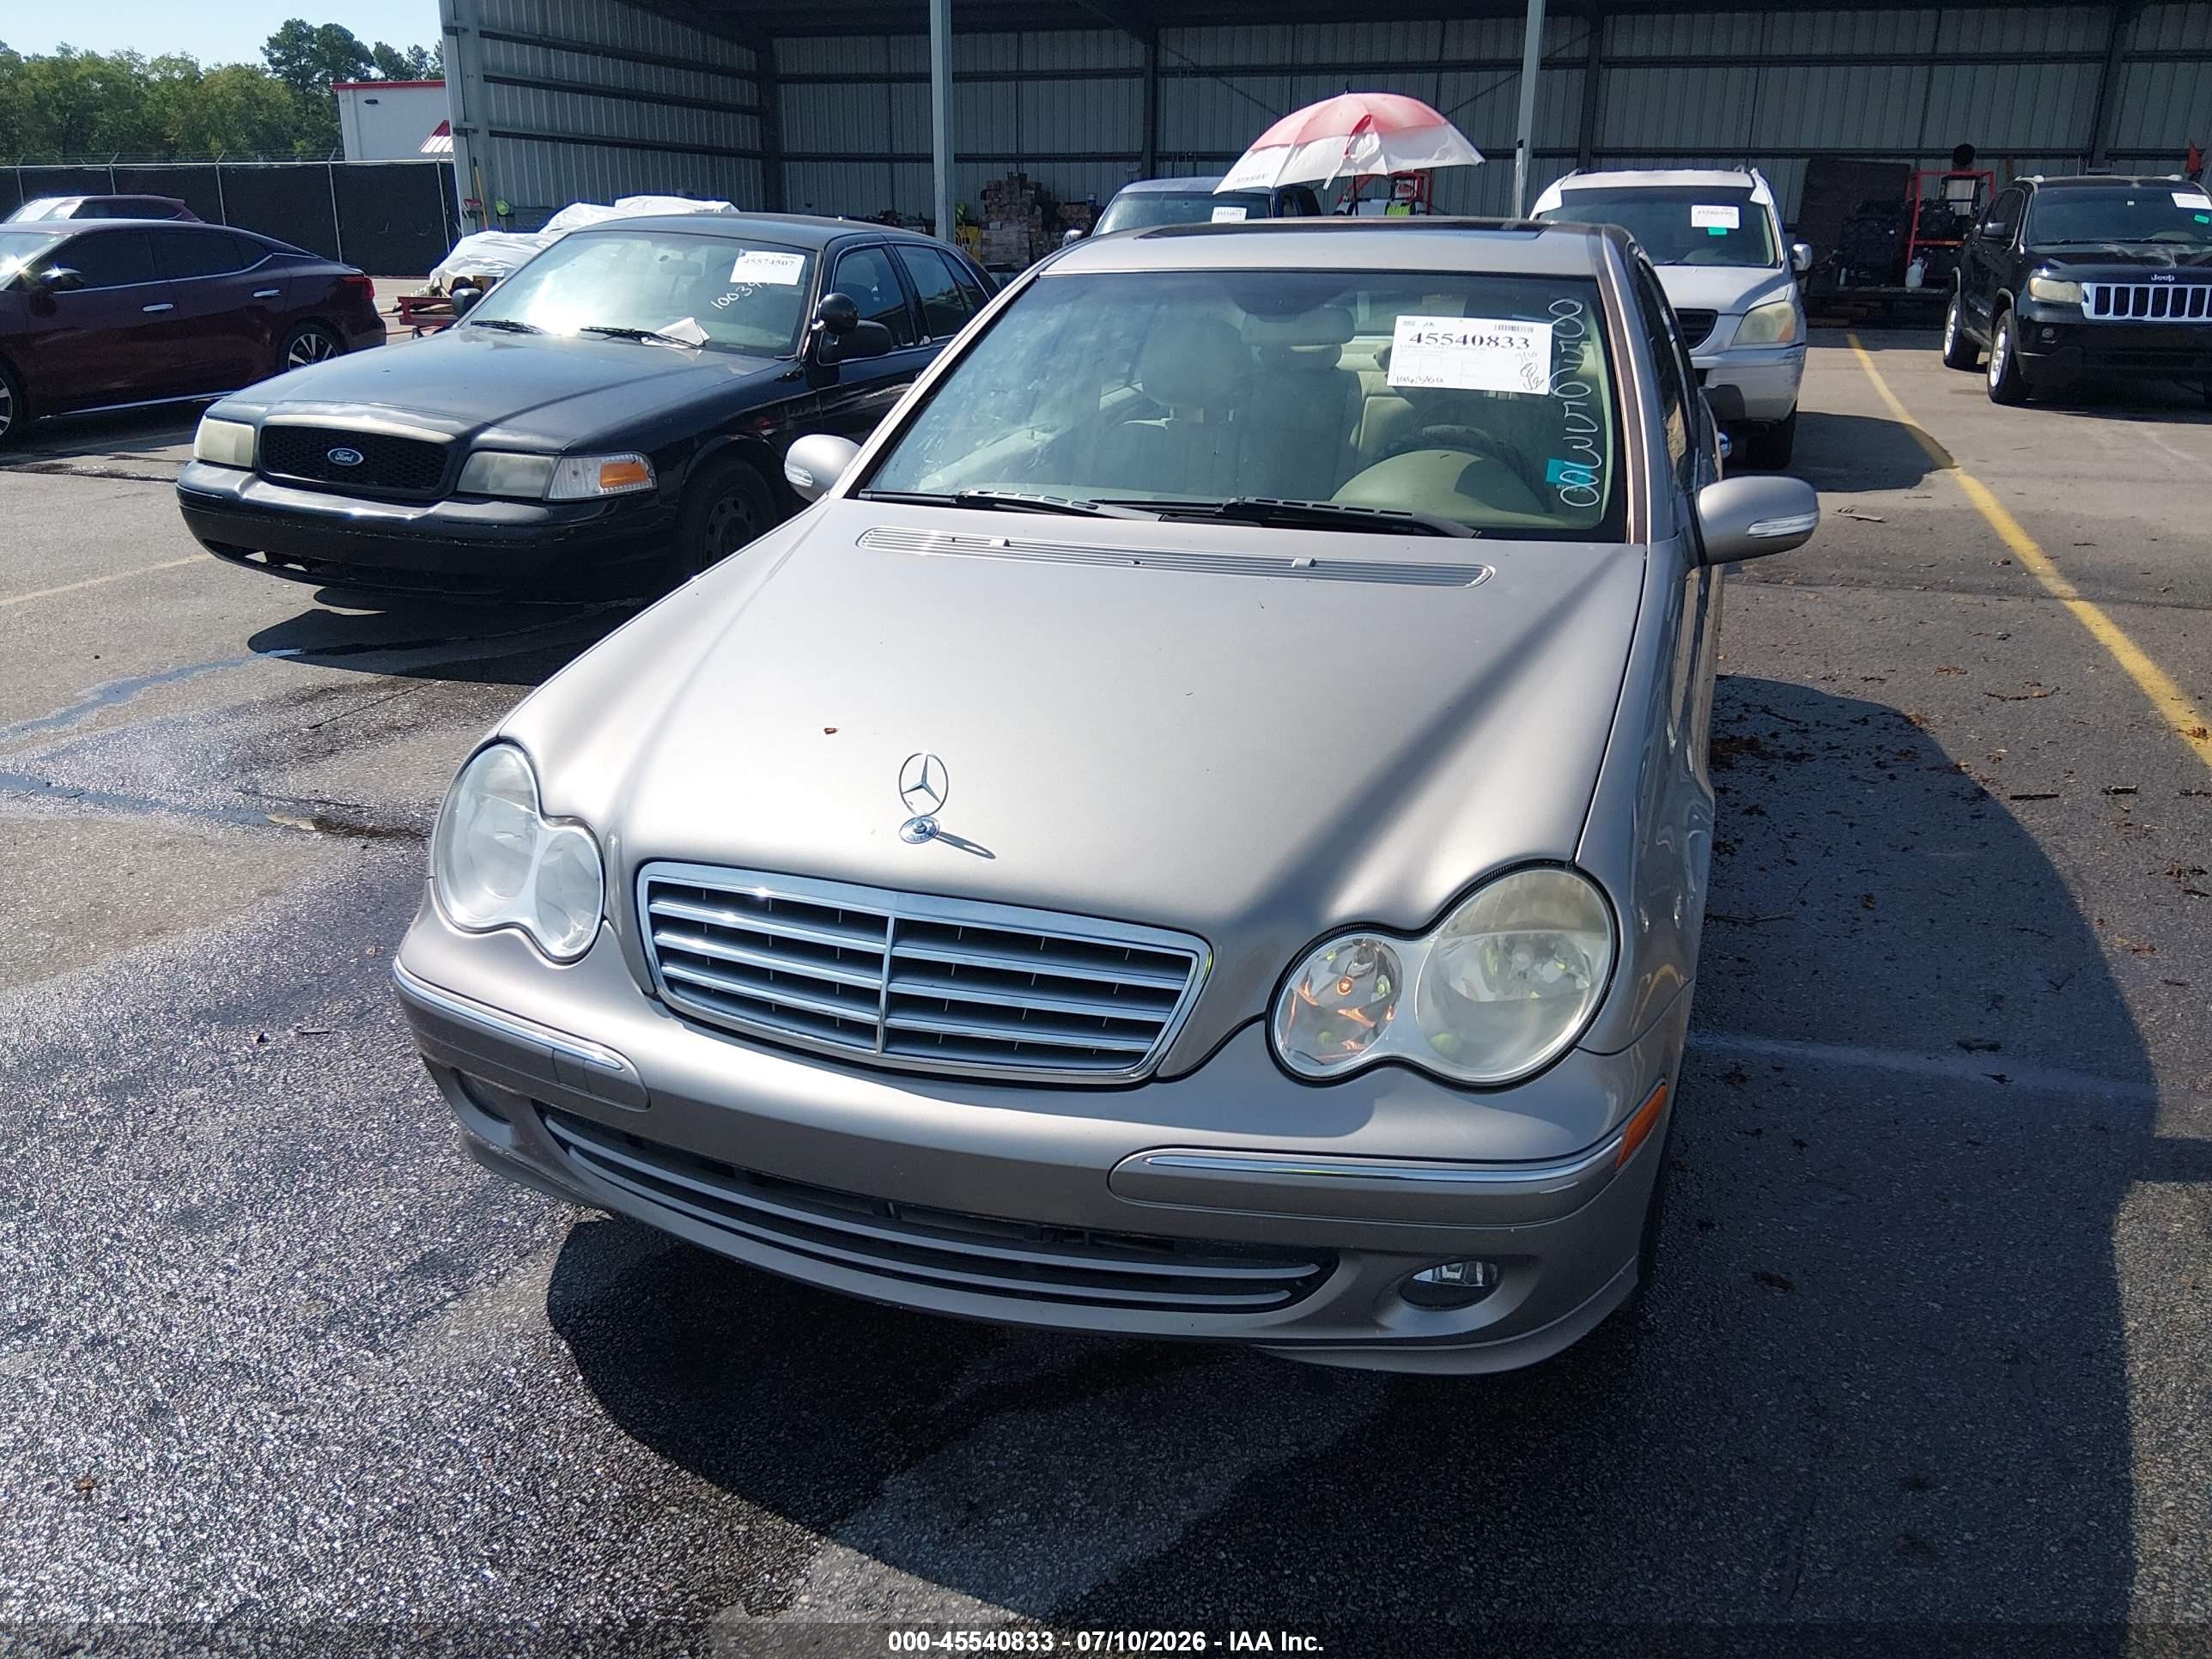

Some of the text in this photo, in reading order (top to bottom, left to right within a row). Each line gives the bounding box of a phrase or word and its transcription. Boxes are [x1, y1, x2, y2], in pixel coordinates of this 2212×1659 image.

[2150, 274, 2176, 283] Jeep
[1409, 331, 1531, 350] 45540833
[335, 451, 354, 462] Ford
